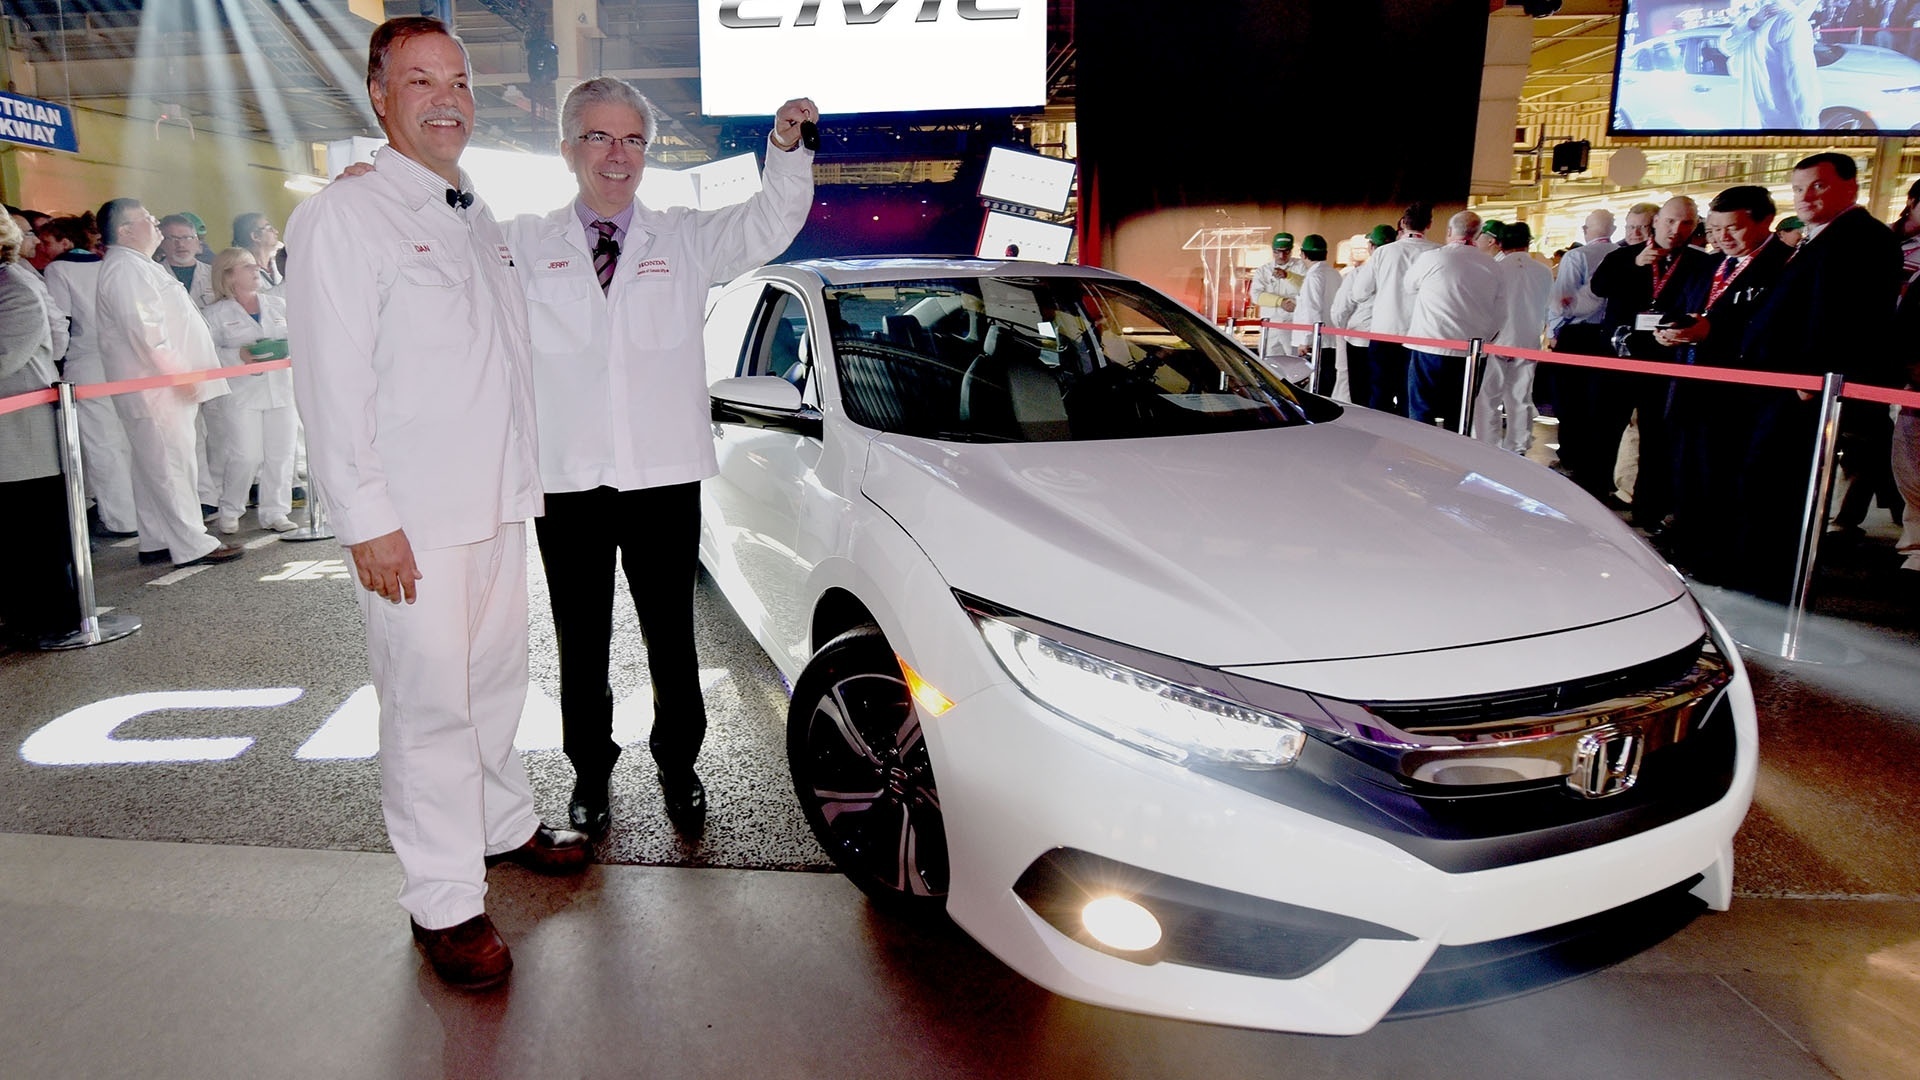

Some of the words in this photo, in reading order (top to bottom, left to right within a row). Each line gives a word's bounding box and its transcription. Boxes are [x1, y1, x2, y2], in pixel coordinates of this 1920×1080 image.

[718, 0, 1021, 29] CIVIC
[0, 96, 62, 127] TRIAN
[414, 244, 431, 253] DAN
[547, 260, 570, 269] JERRY
[638, 260, 667, 269] HONDA
